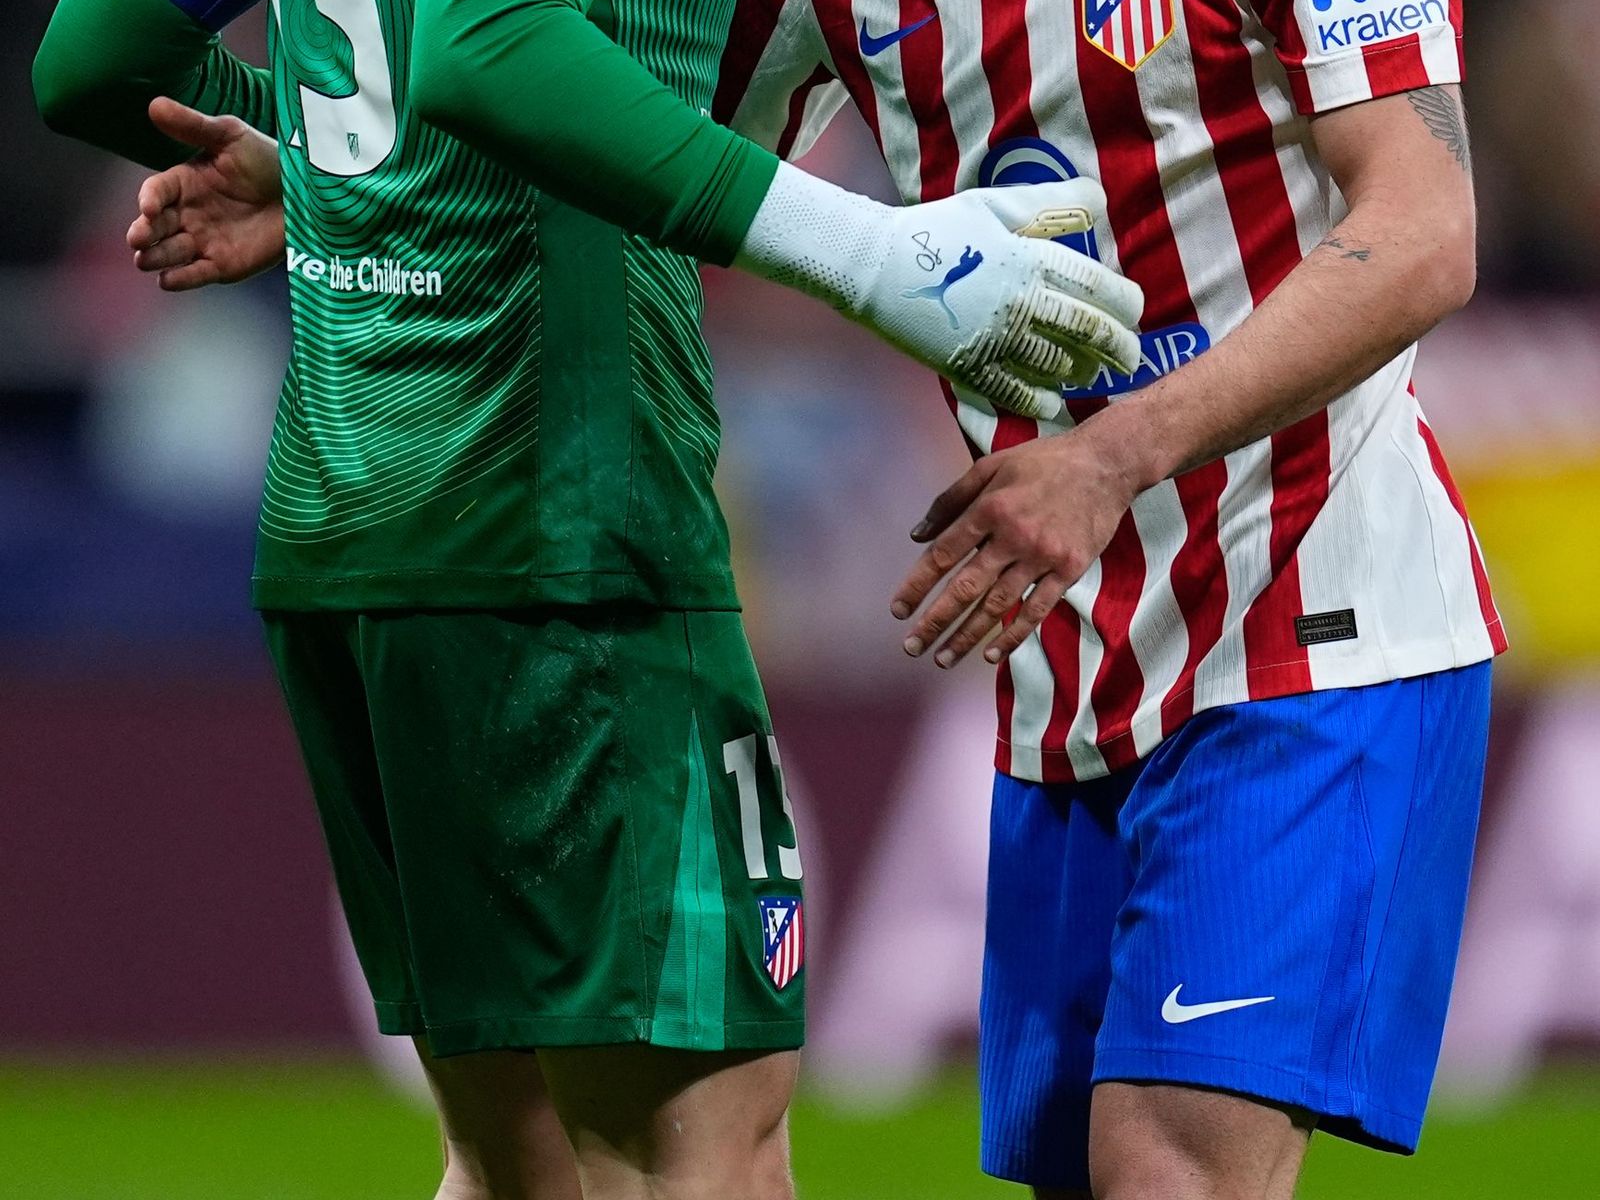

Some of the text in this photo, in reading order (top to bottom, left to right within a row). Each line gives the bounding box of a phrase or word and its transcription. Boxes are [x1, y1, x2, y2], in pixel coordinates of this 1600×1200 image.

[286, 246, 442, 296] ve the Children
